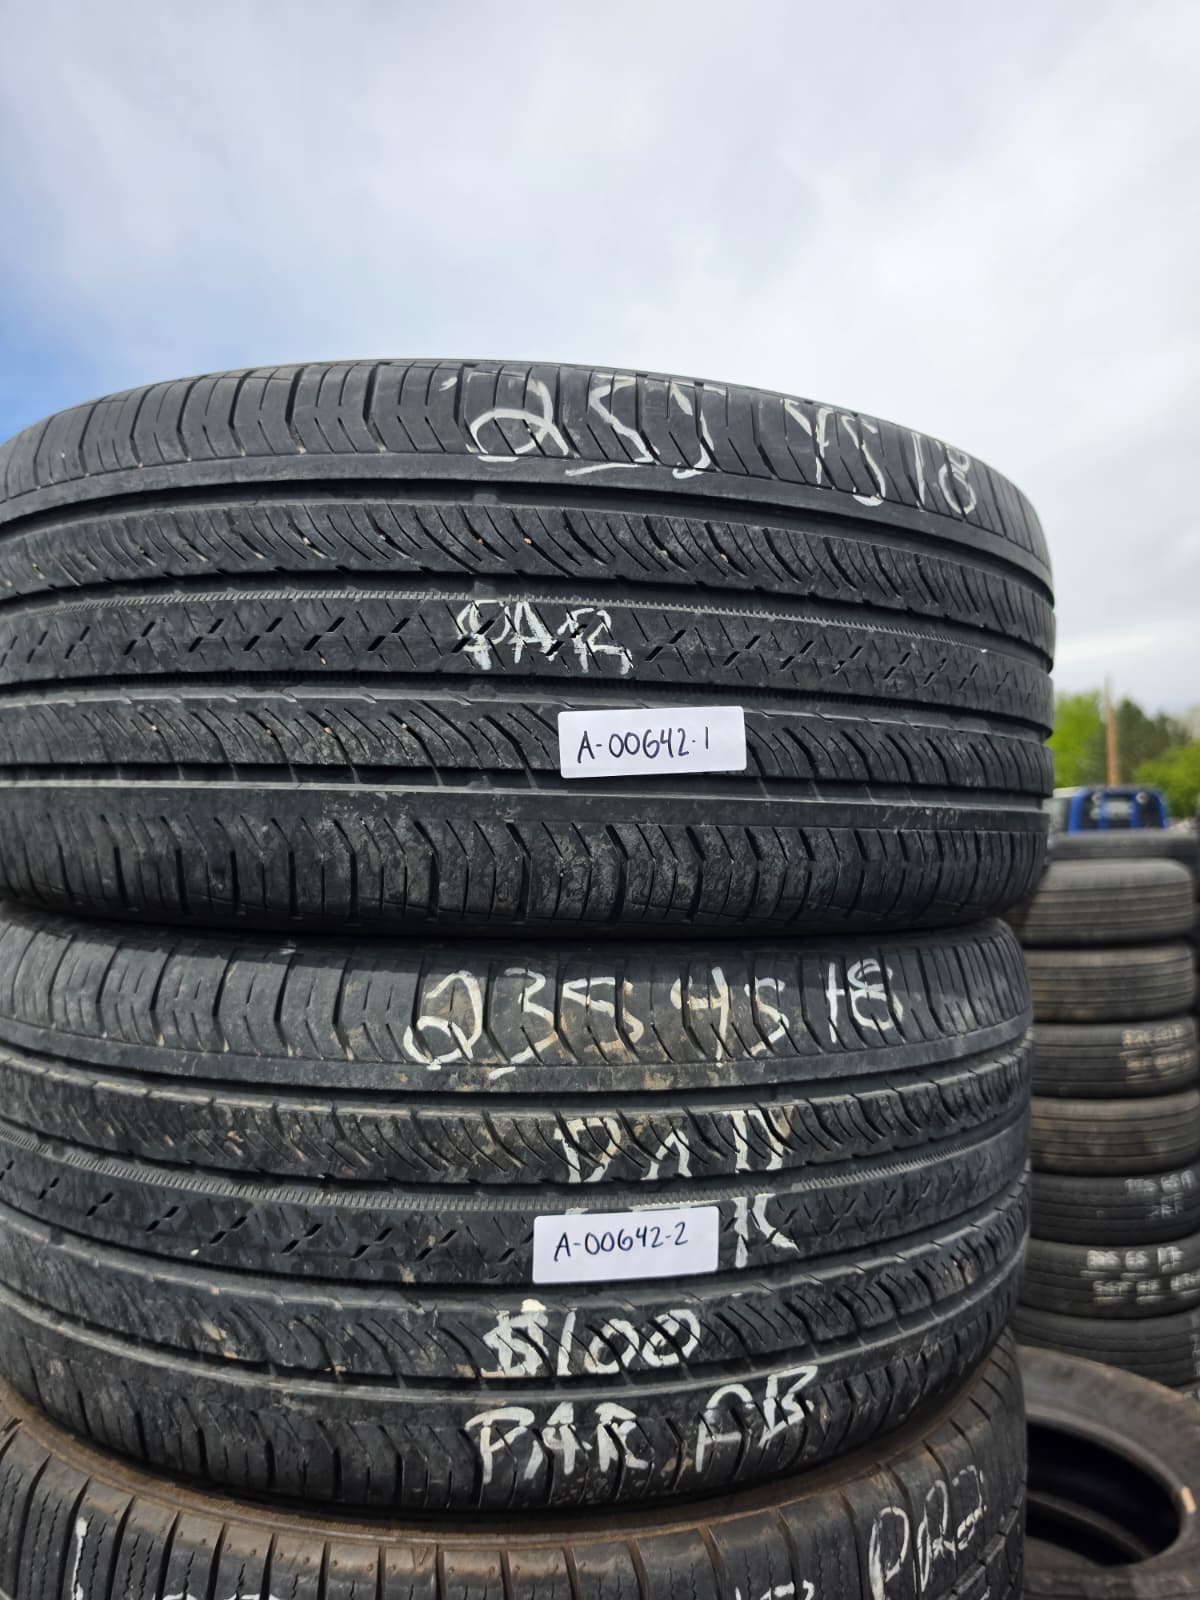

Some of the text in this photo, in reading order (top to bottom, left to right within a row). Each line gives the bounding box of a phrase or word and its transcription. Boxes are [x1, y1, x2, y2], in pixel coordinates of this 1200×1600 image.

[911, 431, 977, 514] 18
[577, 726, 709, 764] A-00642-1
[403, 958, 903, 1080] 235 45 18
[554, 1222, 689, 1262] A-00642-2
[482, 1299, 701, 1376] $100
